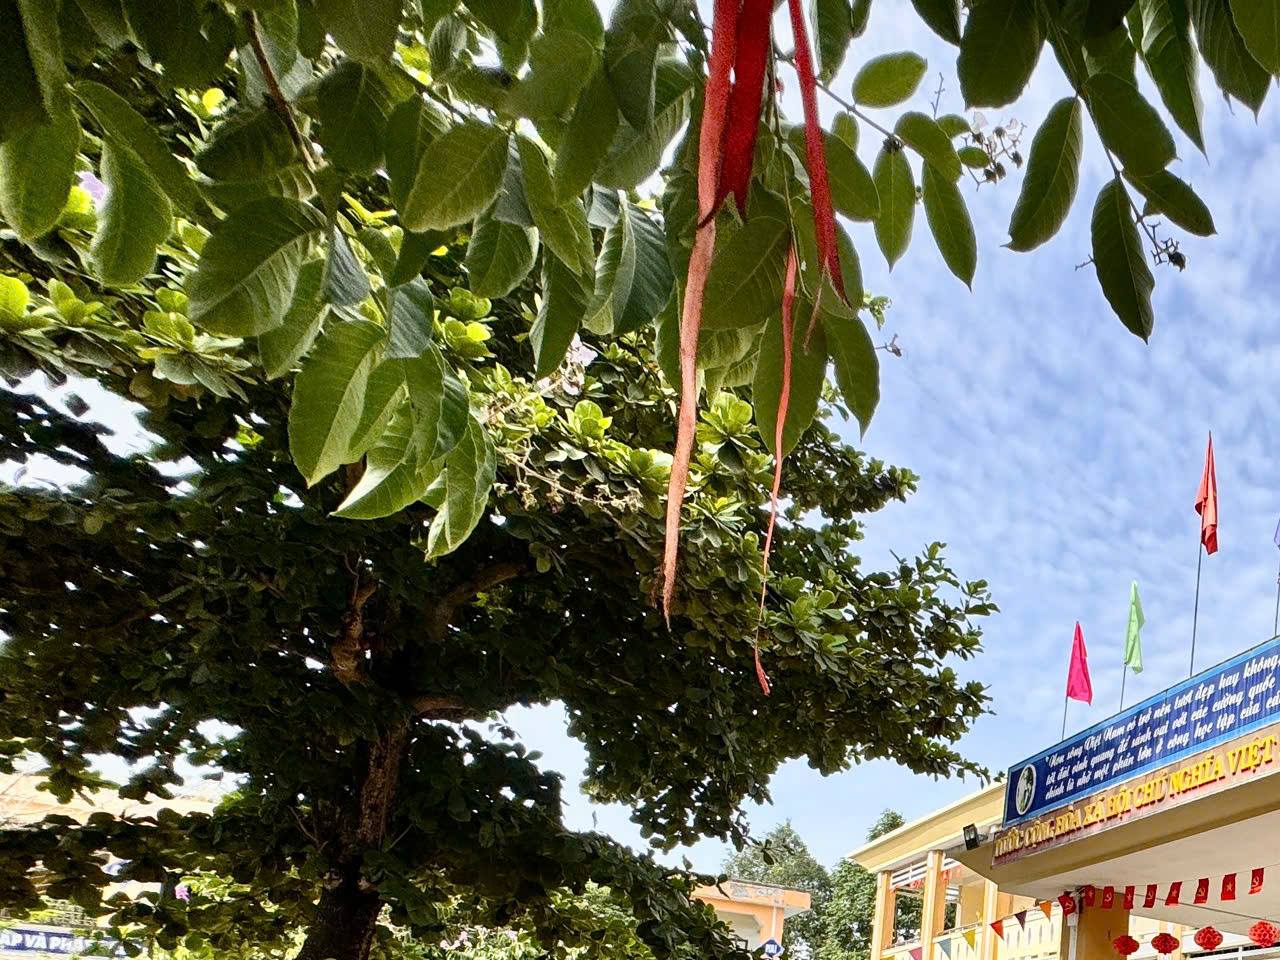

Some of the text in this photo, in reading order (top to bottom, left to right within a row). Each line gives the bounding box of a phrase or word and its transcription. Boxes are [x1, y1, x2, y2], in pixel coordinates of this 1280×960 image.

[1067, 746, 1083, 760] sông
[1084, 734, 1102, 751] Việt
[1103, 726, 1126, 741] Nam
[1127, 716, 1137, 731] có
[1153, 703, 1171, 719] nên
[1195, 683, 1215, 701] đẹp
[1219, 672, 1239, 690] hay
[1131, 727, 1151, 748] sánh
[1153, 721, 1169, 738] vai
[1191, 704, 1209, 721] các
[1212, 691, 1244, 712] cường
[1248, 670, 1276, 699] quốc
[1194, 722, 1213, 740] học
[1217, 713, 1235, 731] tập
[1240, 701, 1260, 719] của
[1024, 819, 1055, 848] CỘNG
[1055, 805, 1081, 836] HÒA
[1083, 795, 1105, 827] XÃ
[1106, 786, 1131, 819] HỘI
[1168, 755, 1225, 796] NGHĨA
[1228, 737, 1276, 776] VIỆT
